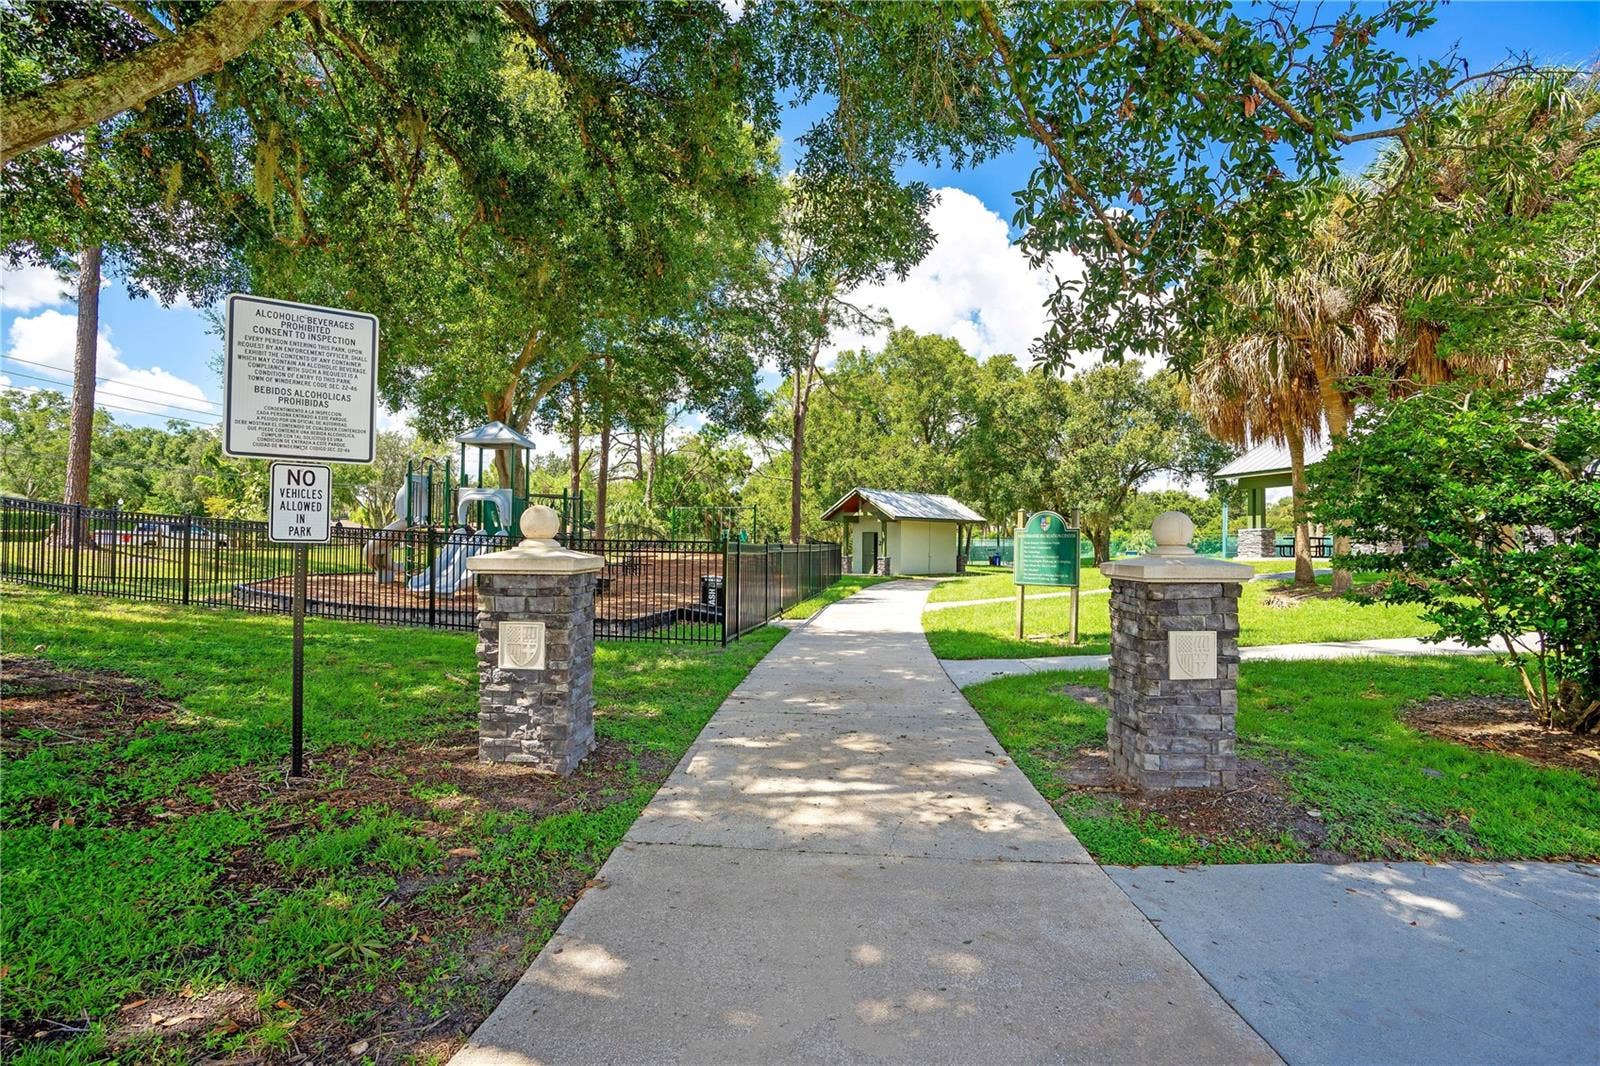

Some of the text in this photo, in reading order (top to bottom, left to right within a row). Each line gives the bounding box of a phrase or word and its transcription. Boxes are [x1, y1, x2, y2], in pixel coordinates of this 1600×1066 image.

[255, 309, 354, 330] ALCOHOLIC BEVERAGES
[280, 321, 330, 335] PROHIBITED
[252, 326, 292, 338] CONSENT
[307, 334, 355, 346] INSPECTION
[237, 340, 263, 348] REQUEST
[284, 347, 324, 356] ENFORCEMENT
[289, 341, 316, 349] ENTERING
[280, 353, 309, 361] CONTENTS
[331, 359, 360, 367] CONTAINER
[247, 362, 284, 371] COMPLIANCE
[307, 362, 337, 370] ALCOHOLIC
[254, 369, 285, 377] CONDITION
[274, 378, 311, 386] WINDERMERE
[254, 385, 351, 402] BEBIDOS ALCOHOLICAS
[278, 396, 328, 408] PROHIBIDAS
[288, 469, 316, 486] NO
[280, 488, 322, 499] VEHICLES
[280, 500, 322, 511] ALLOWED
[296, 514, 305, 523] IN
[288, 526, 312, 536] PARK
